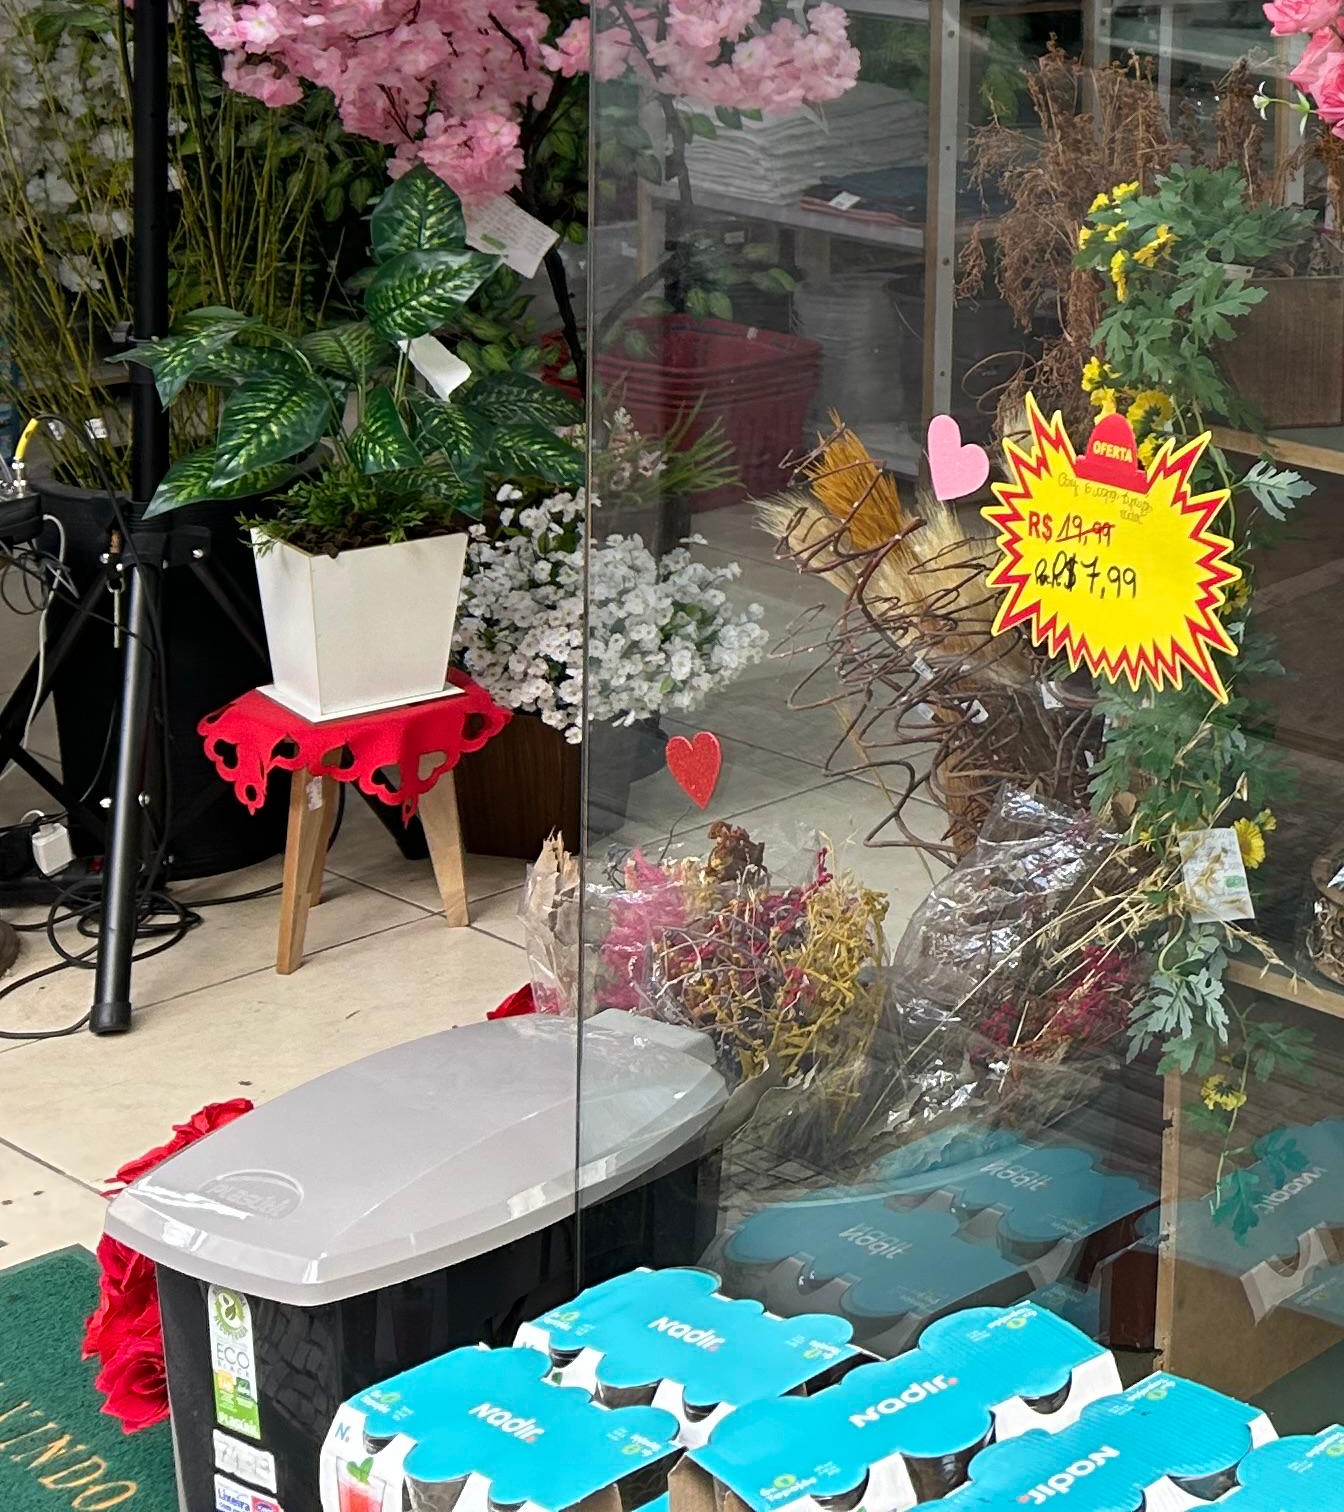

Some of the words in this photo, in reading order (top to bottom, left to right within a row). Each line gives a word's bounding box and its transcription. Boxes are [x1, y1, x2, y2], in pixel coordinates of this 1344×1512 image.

[1092, 440, 1134, 464] OFERTA
[1028, 510, 1053, 544] R$
[1080, 555, 1138, 599] 7,99
[216, 1342, 250, 1370] ECO
